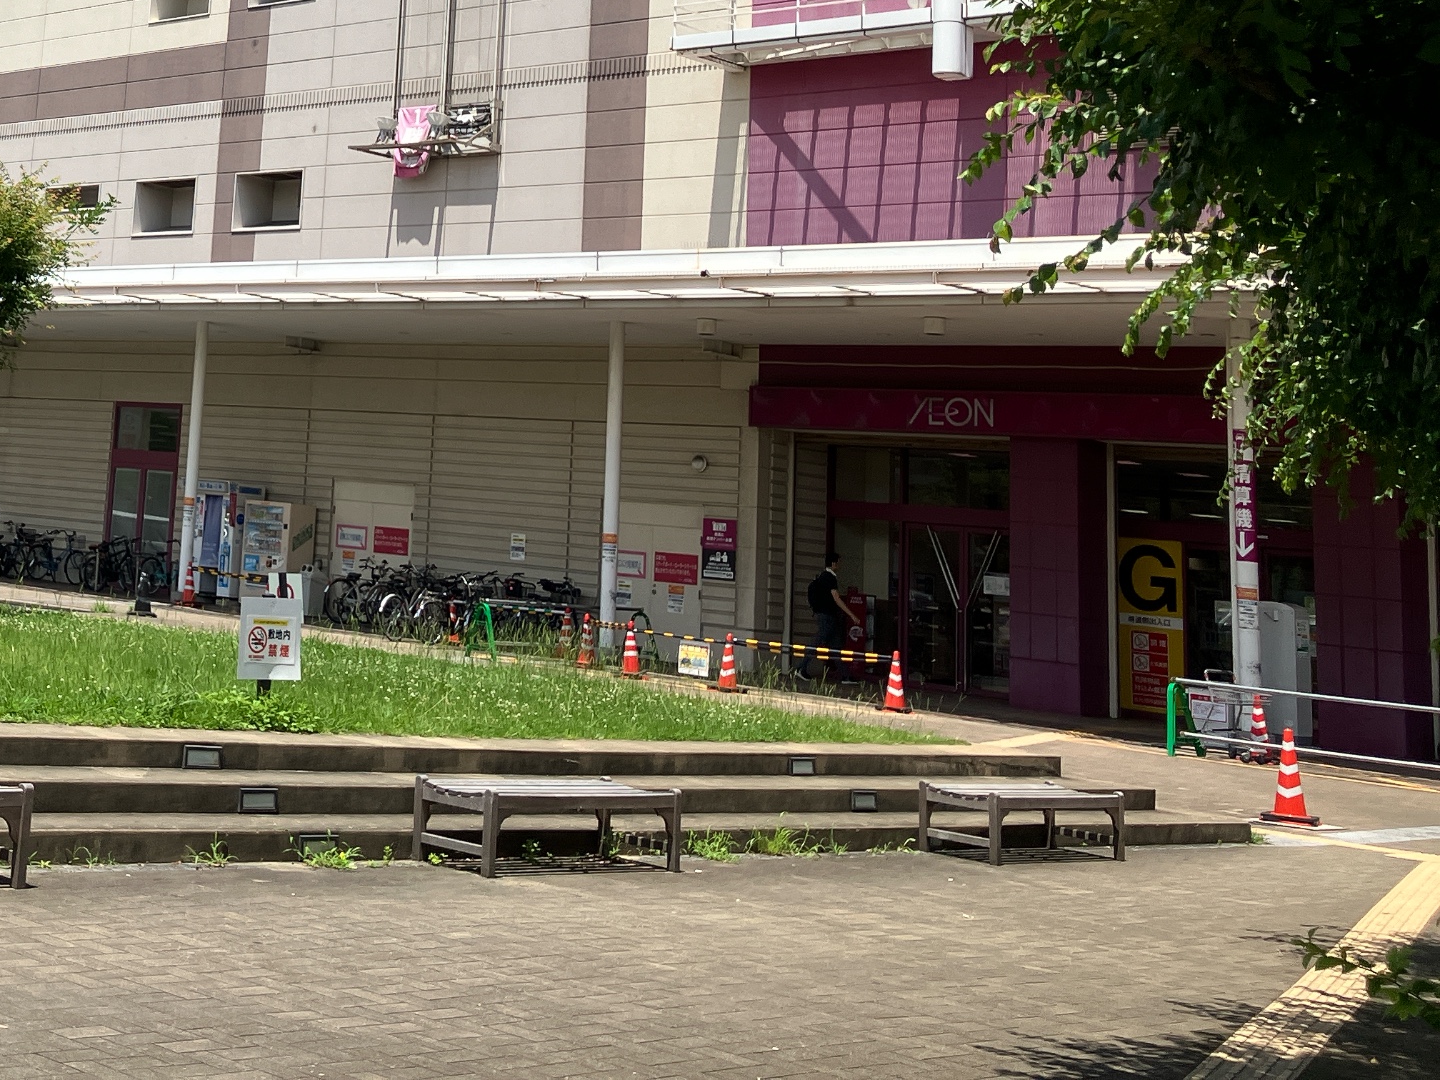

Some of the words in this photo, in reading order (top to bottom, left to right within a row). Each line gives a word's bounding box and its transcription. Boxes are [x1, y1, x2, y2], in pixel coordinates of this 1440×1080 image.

[1119, 543, 1177, 613] G
[268, 628, 291, 641] 敷地内
